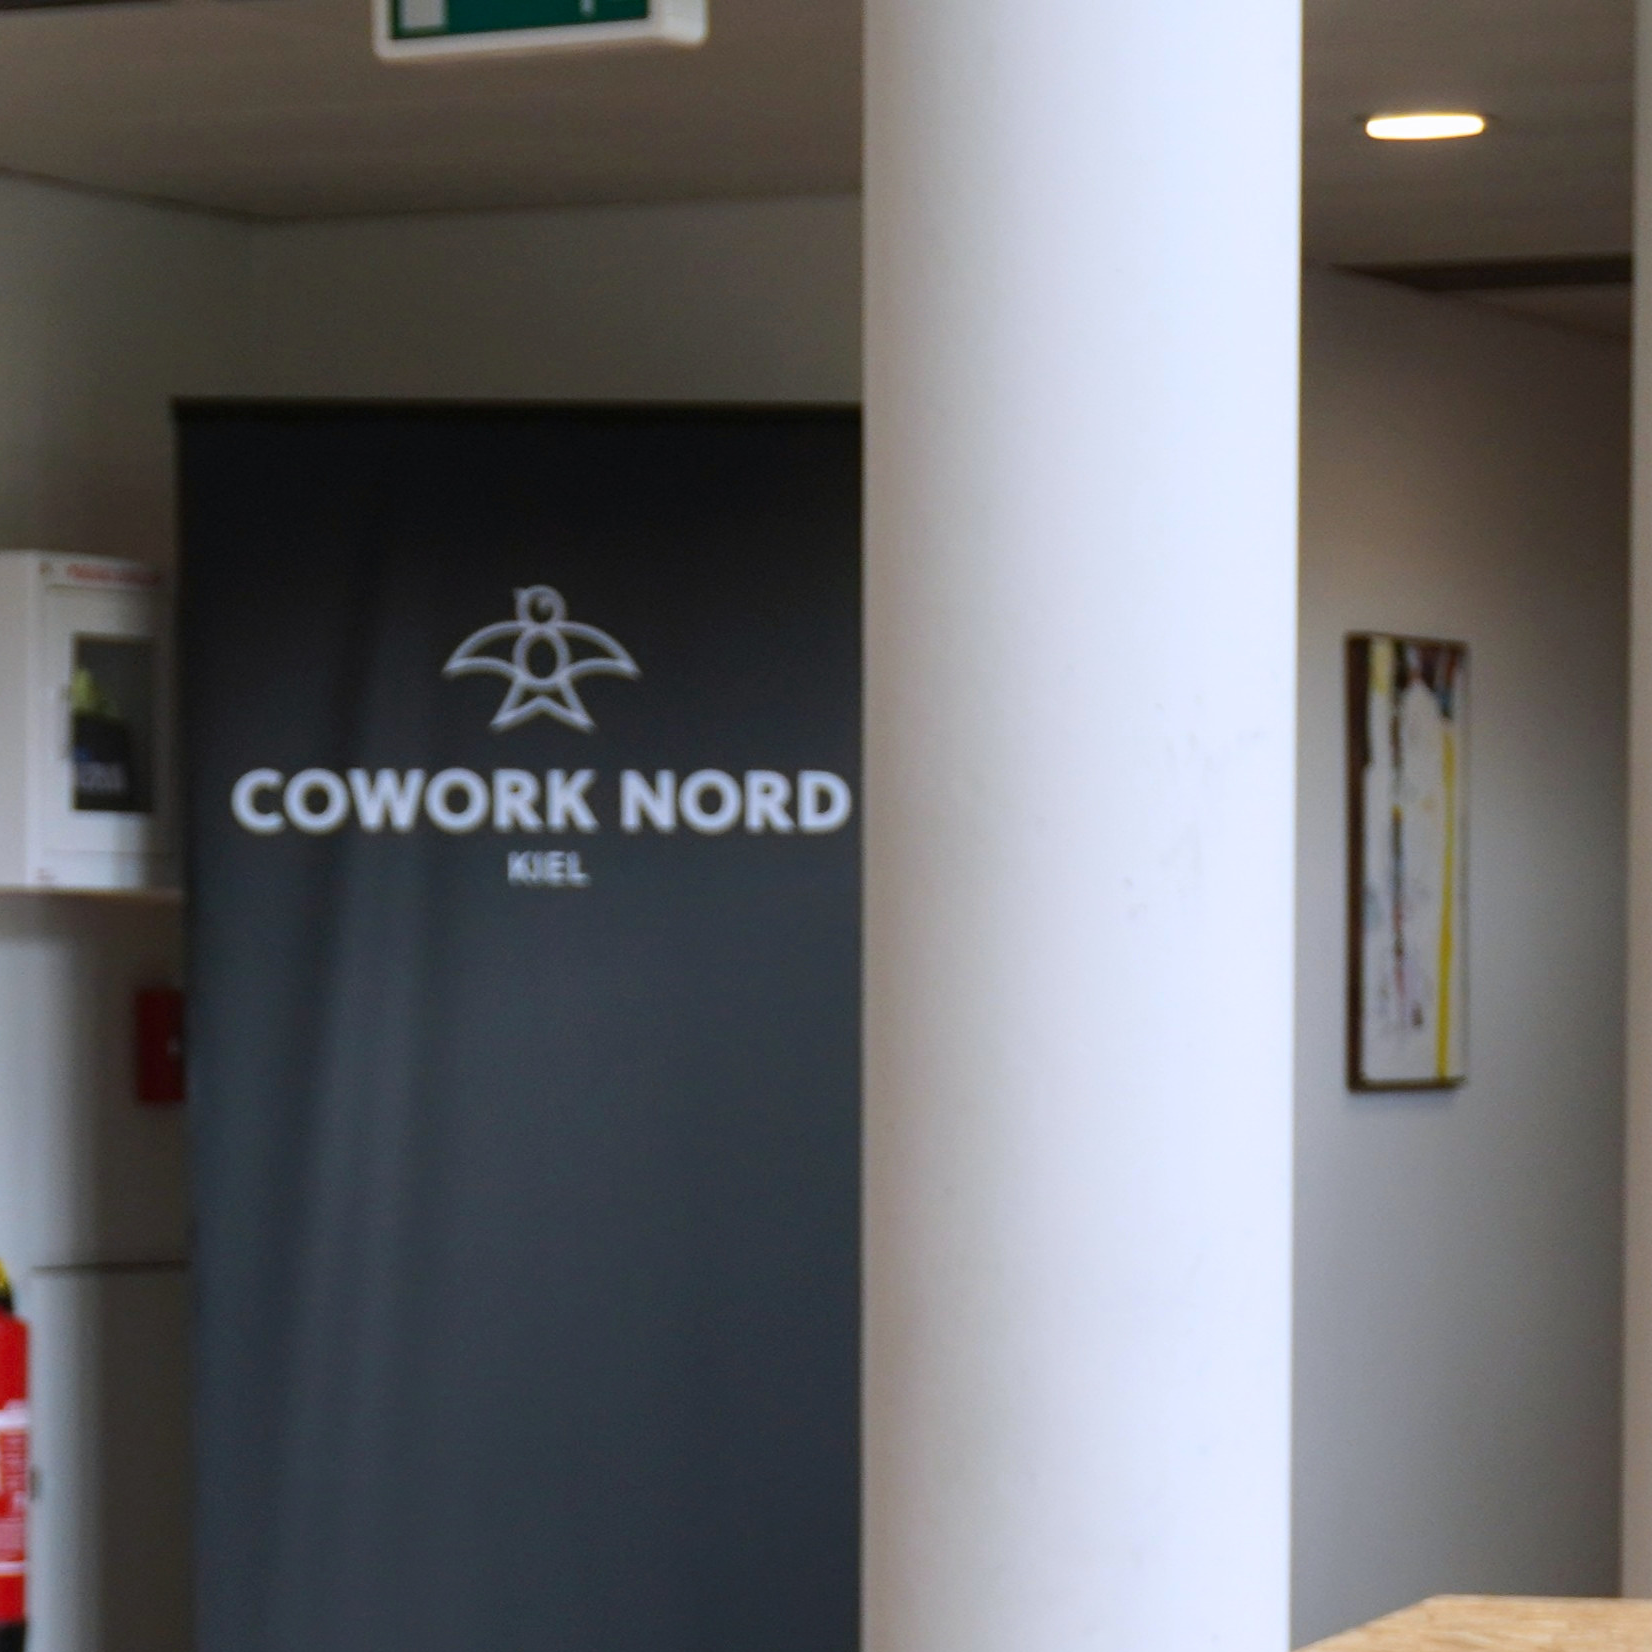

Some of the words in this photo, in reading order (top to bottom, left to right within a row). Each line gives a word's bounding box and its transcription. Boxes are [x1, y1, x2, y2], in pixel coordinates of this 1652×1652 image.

[230, 767, 600, 835] COWORK
[619, 768, 853, 835] NORD
[506, 850, 591, 888] KIEL
